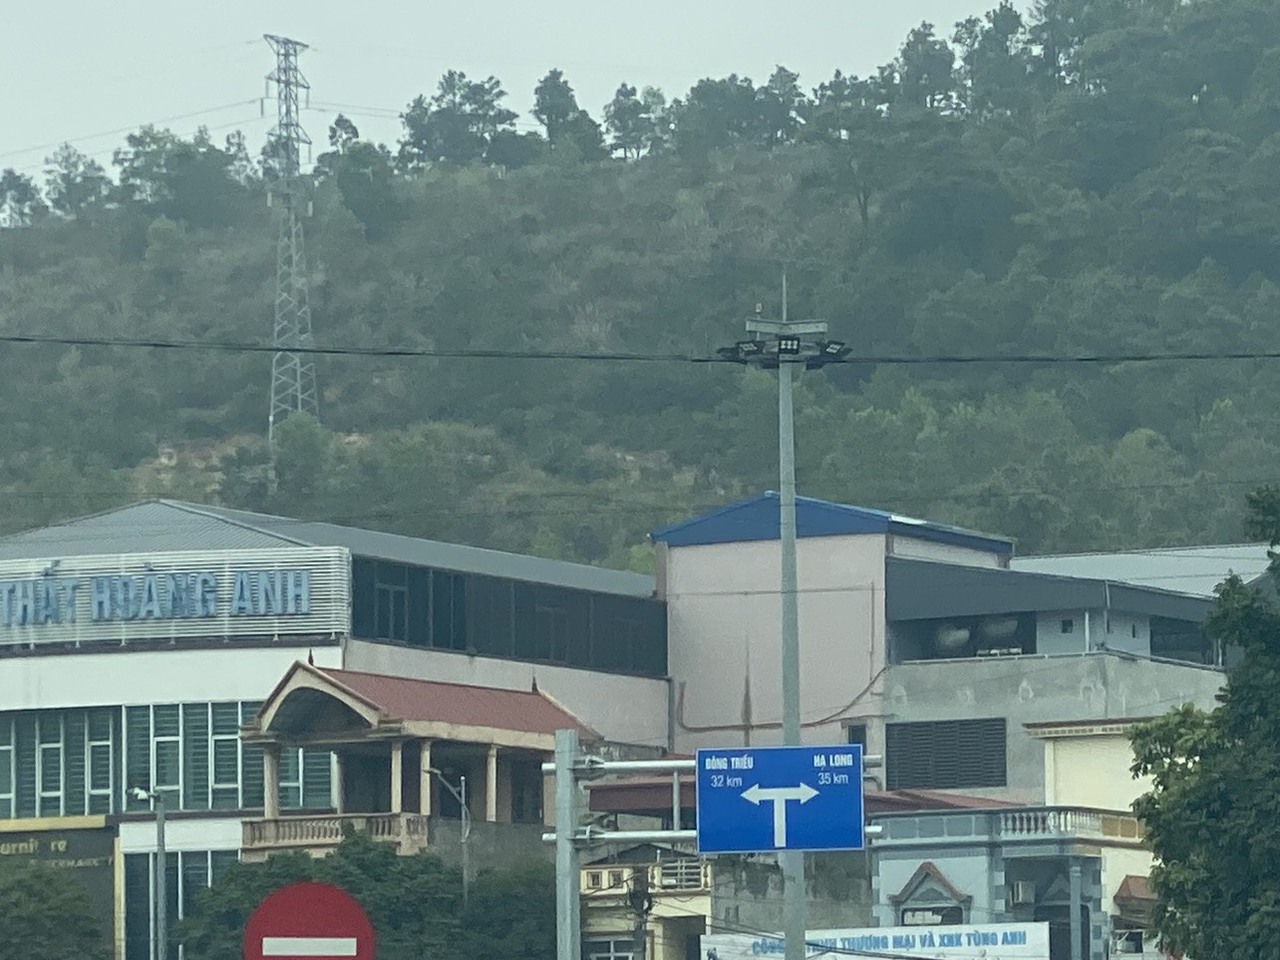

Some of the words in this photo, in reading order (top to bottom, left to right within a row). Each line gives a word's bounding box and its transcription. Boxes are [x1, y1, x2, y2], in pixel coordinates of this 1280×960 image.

[90, 561, 217, 622] HOÀNG
[230, 569, 312, 617] ANH
[813, 754, 827, 771] HẠ
[829, 754, 853, 767] LONG
[710, 774, 724, 788] 32
[726, 774, 743, 788] km
[817, 771, 832, 785] 35
[833, 771, 849, 785] km
[919, 931, 936, 948] VÀ
[966, 930, 999, 947] TÙNG
[1002, 930, 1027, 946] ANH
